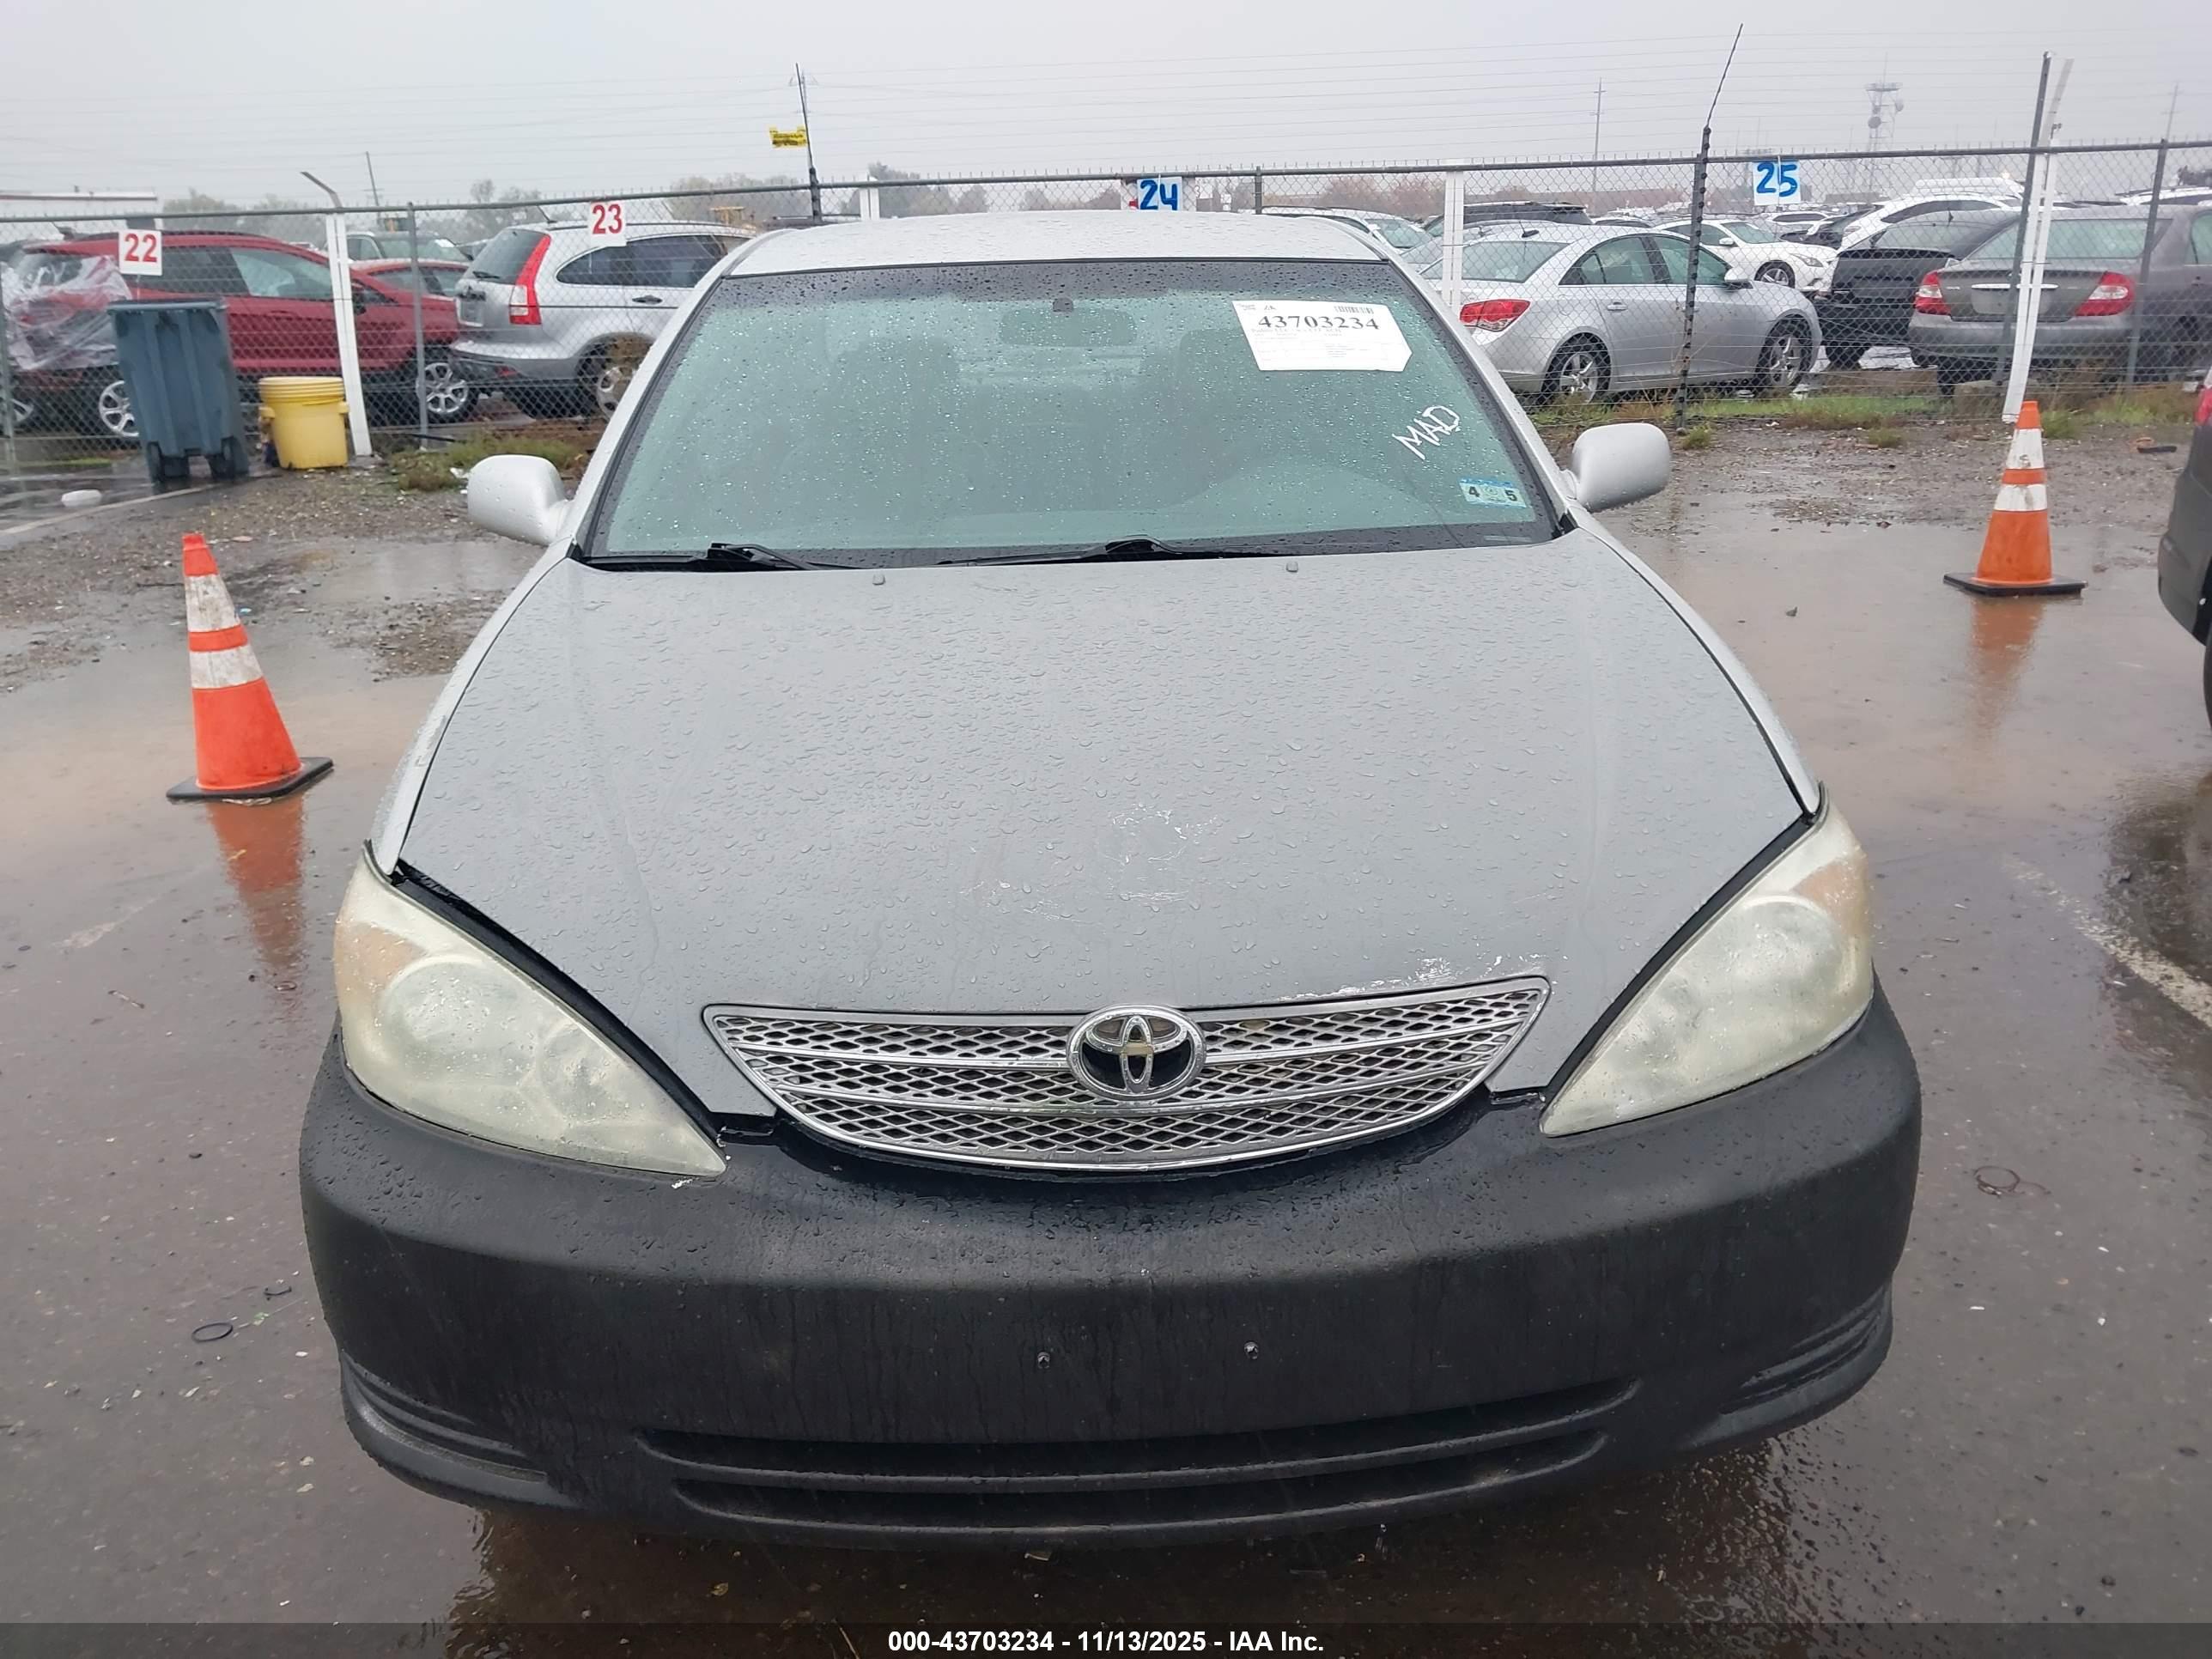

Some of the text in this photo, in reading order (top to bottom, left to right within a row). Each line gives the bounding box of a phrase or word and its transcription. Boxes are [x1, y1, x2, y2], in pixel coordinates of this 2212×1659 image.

[1139, 179, 1178, 211] 24
[1757, 162, 1798, 198] 25
[592, 204, 623, 234] 23
[125, 233, 157, 263] 22
[1258, 315, 1380, 330] 43703234
[1391, 405, 1461, 460] MAD
[1468, 486, 1517, 501] 4 5
